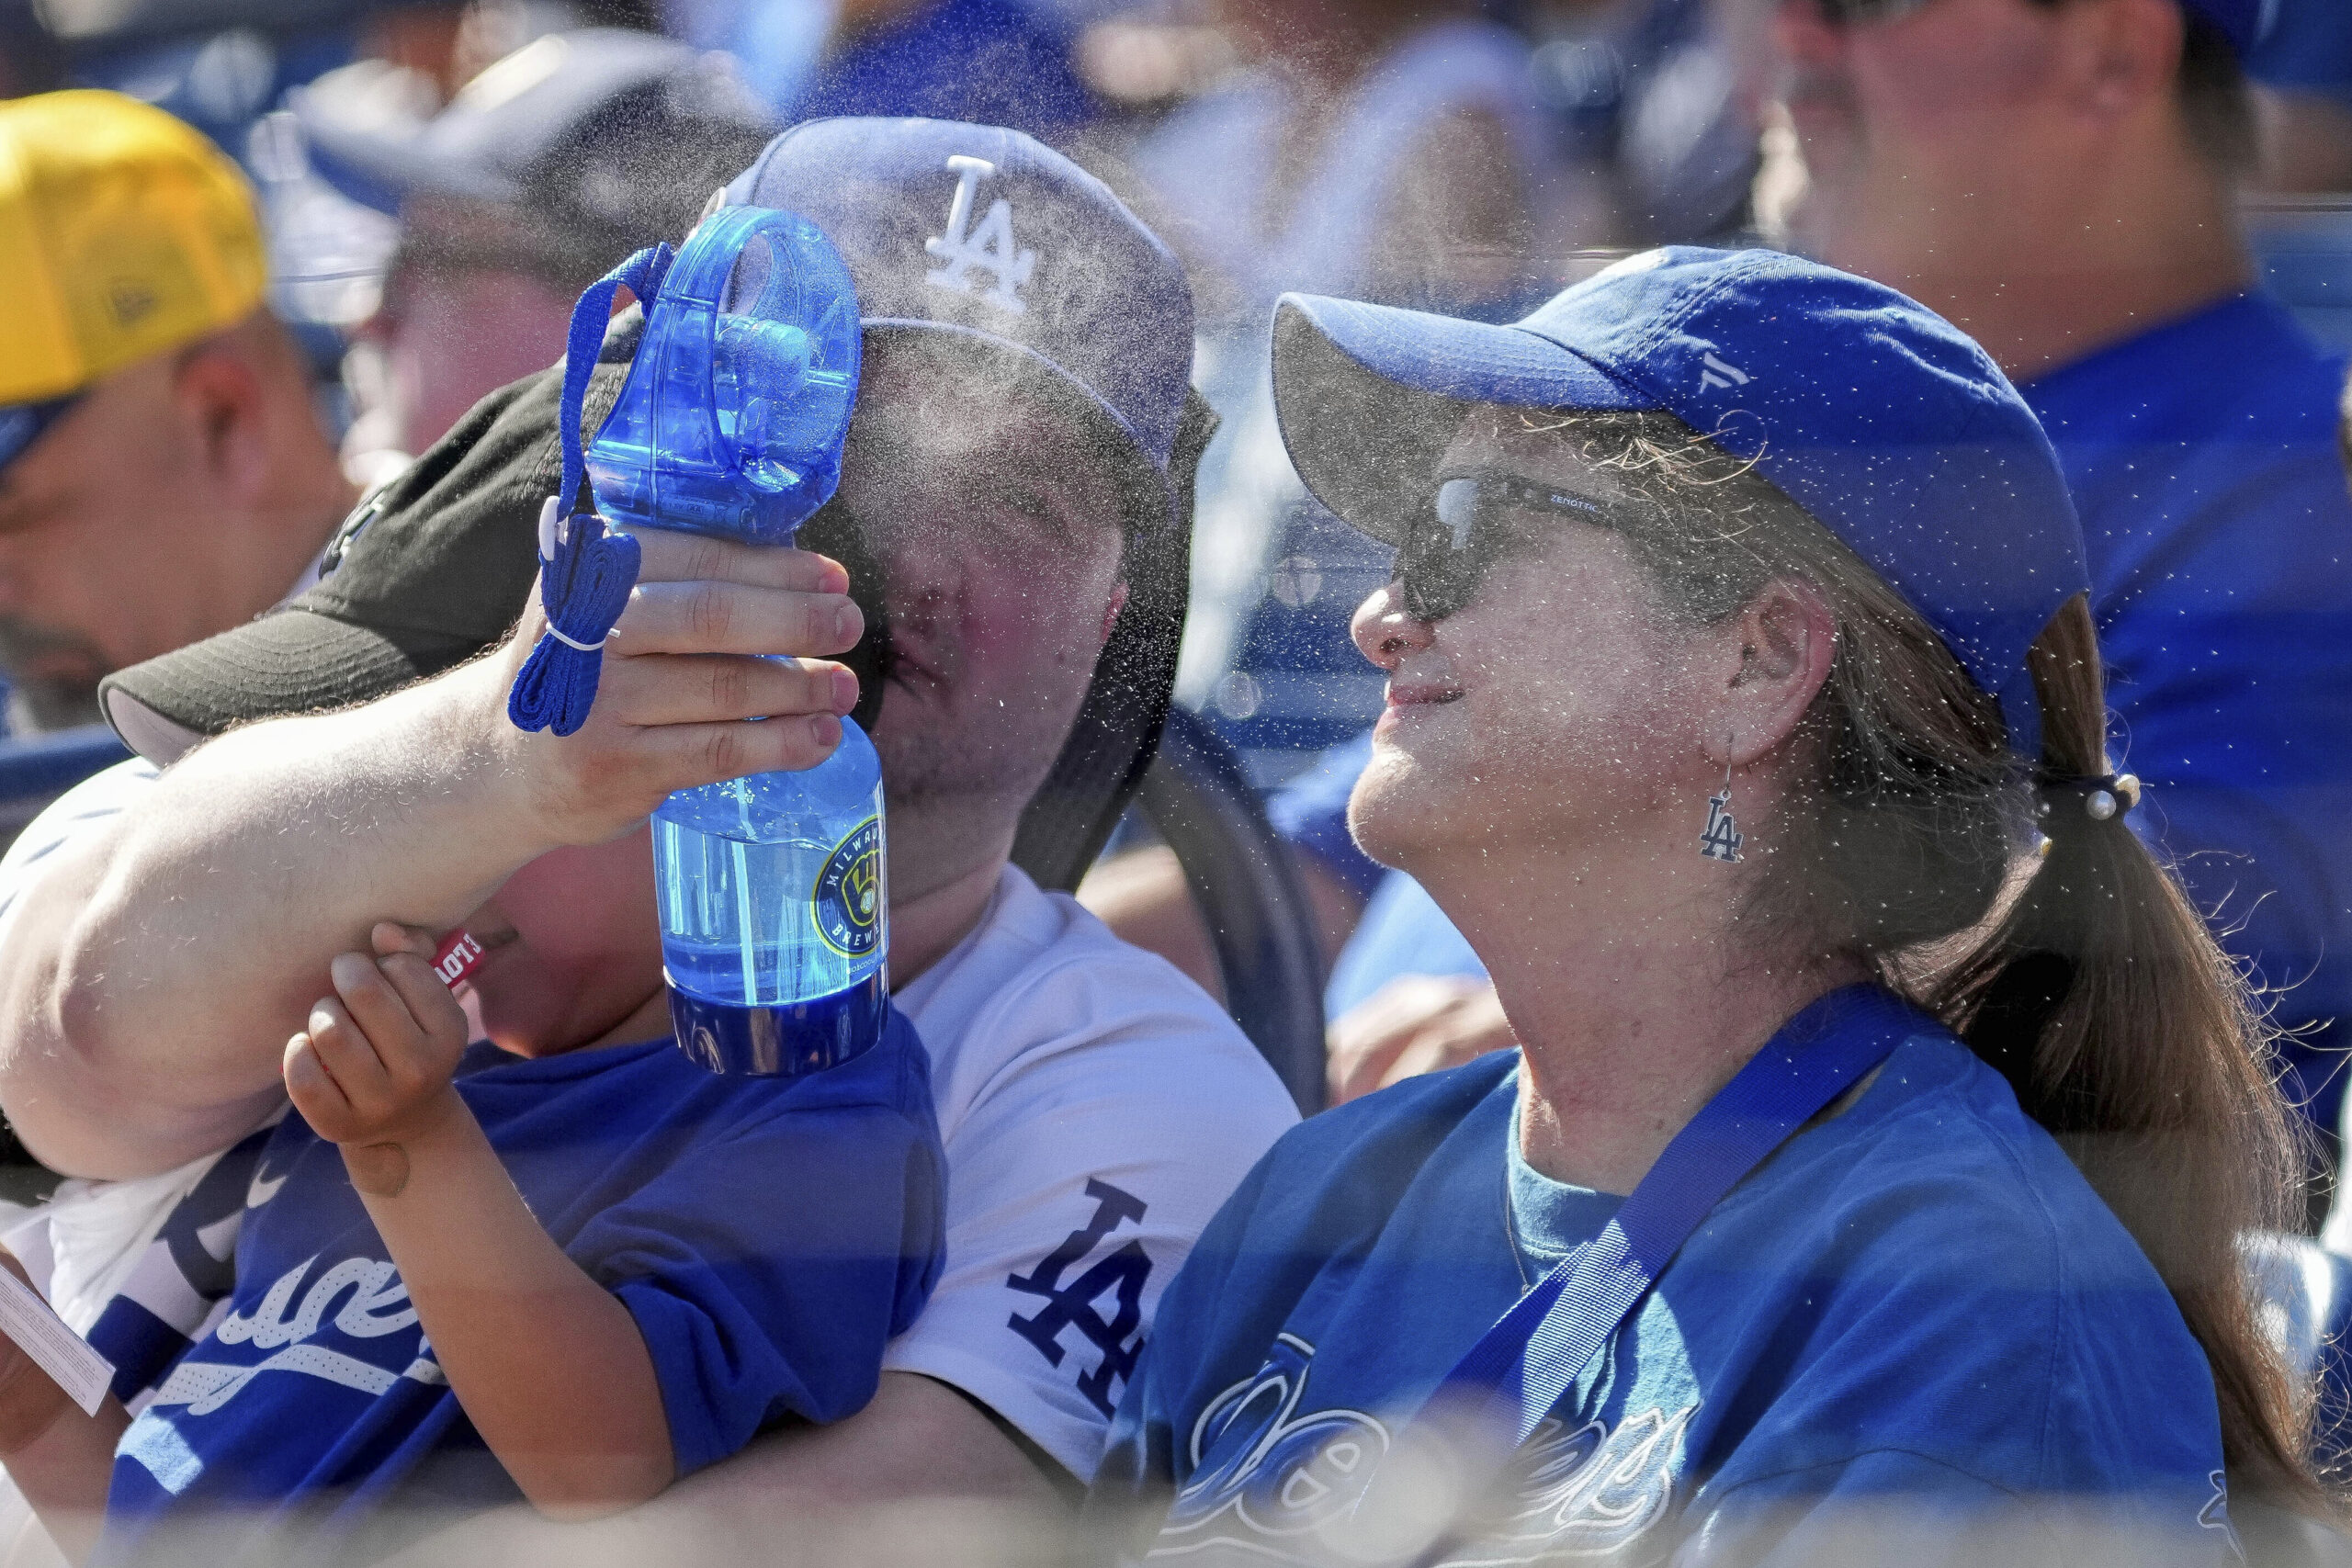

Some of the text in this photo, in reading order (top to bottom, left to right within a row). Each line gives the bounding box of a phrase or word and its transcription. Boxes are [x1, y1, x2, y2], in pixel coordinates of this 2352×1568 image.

[926, 154, 1035, 314] LA
[1551, 494, 1600, 513] ZENOTTIC
[827, 828, 878, 886] MILWAU
[1700, 796, 1744, 863] LA
[831, 922, 879, 946] BREWE
[1006, 1177, 1153, 1423] LA
